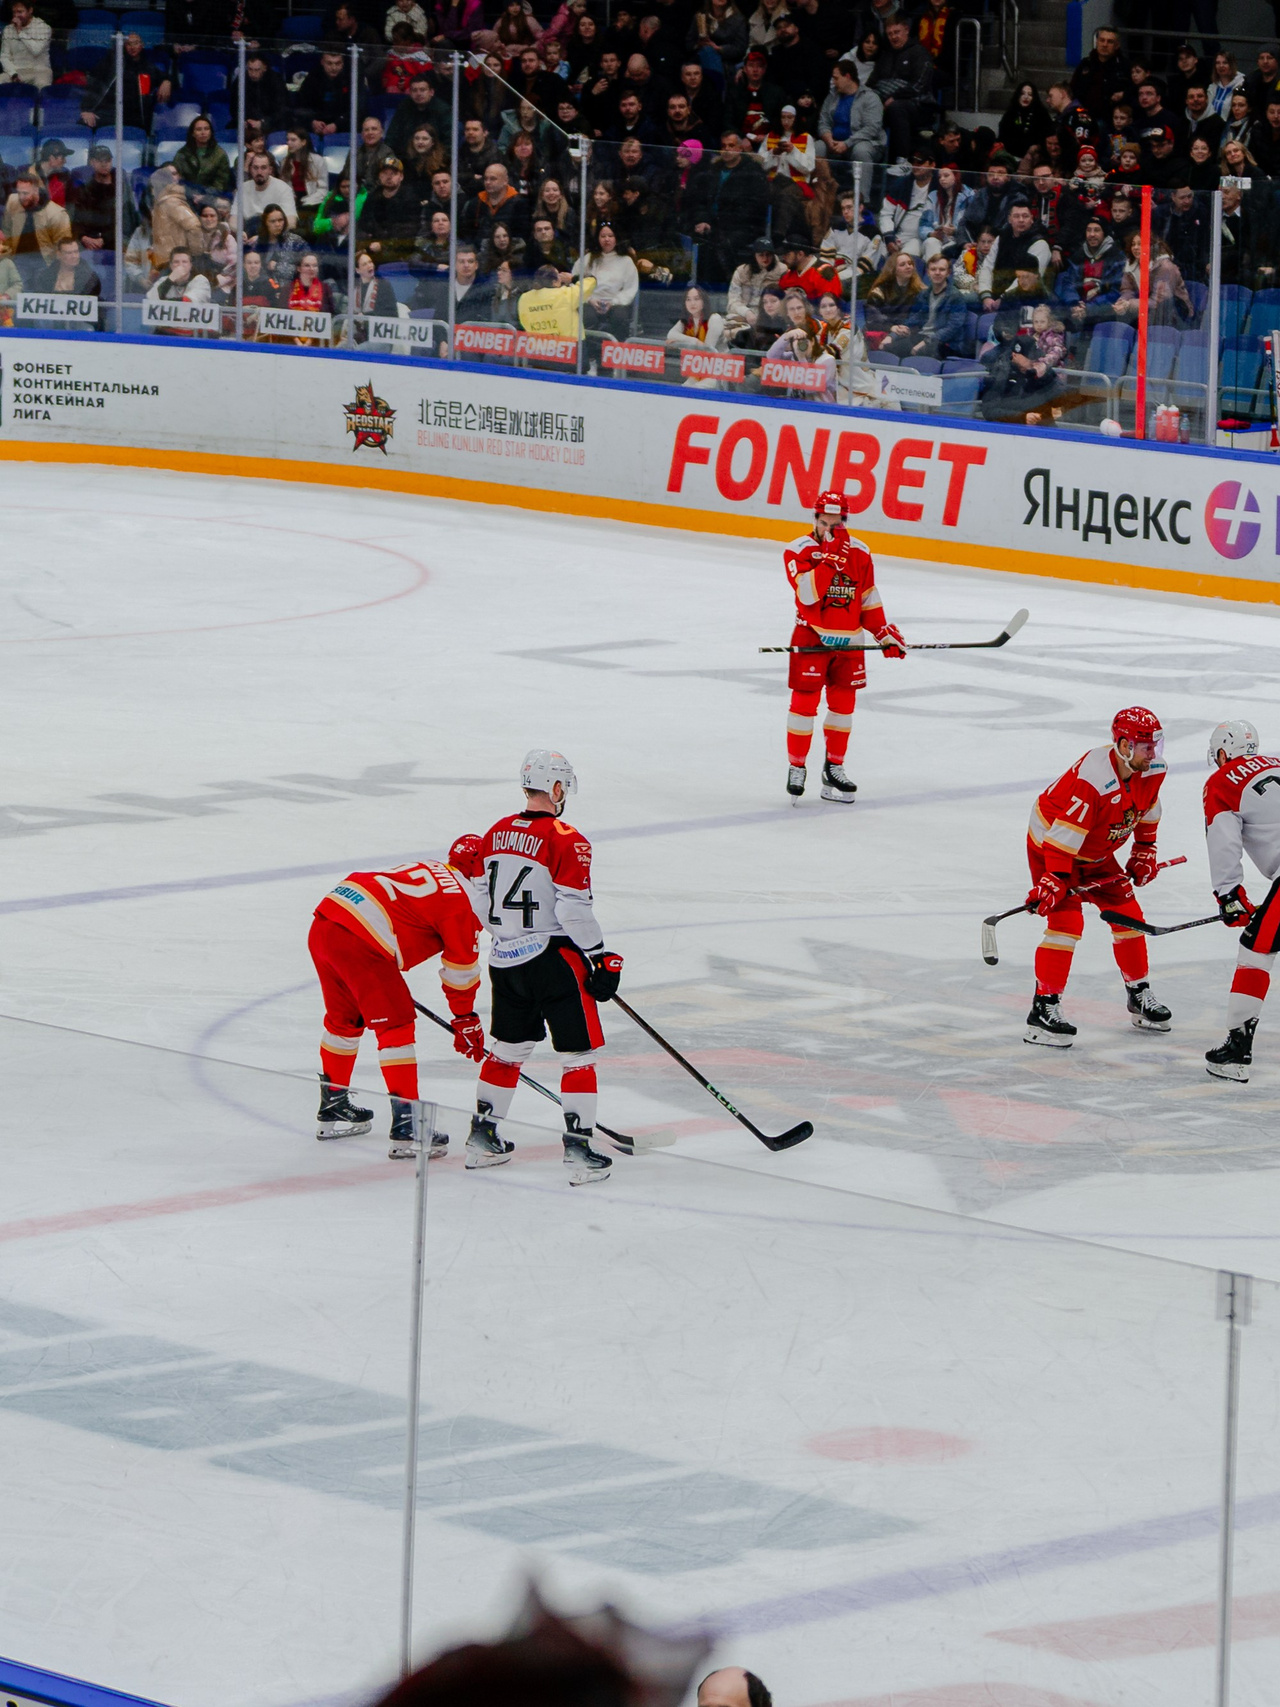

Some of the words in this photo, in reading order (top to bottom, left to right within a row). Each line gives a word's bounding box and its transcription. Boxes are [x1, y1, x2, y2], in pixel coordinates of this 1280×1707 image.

[22, 297, 92, 316] KHL.RU
[147, 304, 214, 323] KHL.RU
[528, 304, 553, 313] SAFETY
[264, 313, 327, 333] KHL.RU
[373, 322, 429, 342] KHL.RU
[454, 329, 514, 352] FONBET
[516, 335, 577, 359] FONBET
[602, 345, 664, 369] FONBET
[681, 354, 744, 378] FONBET
[13, 362, 73, 375] ФОНБЕТ
[762, 362, 826, 388] FONBET
[13, 377, 160, 396] КОНТИНЕНТАЛЬНАЯ
[890, 384, 936, 399] Ростелеком
[13, 392, 105, 408] ХОККЕЙНАЯ
[13, 408, 52, 421] ЛИГА
[417, 398, 585, 443] 北京昆仑鸿星冰球俱乐部
[417, 430, 450, 449] BEIJING
[452, 433, 485, 453] KUNLUN
[486, 438, 503, 456] RED
[505, 440, 526, 458] STAR
[528, 443, 561, 463] HOCKEY
[563, 448, 586, 466] CLUB
[667, 413, 987, 527] FONBET
[1023, 467, 1192, 545] Яндекс
[787, 559, 798, 577] 9
[522, 774, 532, 786] 14
[1065, 795, 1090, 823] 71
[492, 831, 544, 857] IGUMNOV
[1130, 851, 1157, 860] CCM
[332, 885, 366, 905] SIBUR
[487, 860, 540, 929] 14
